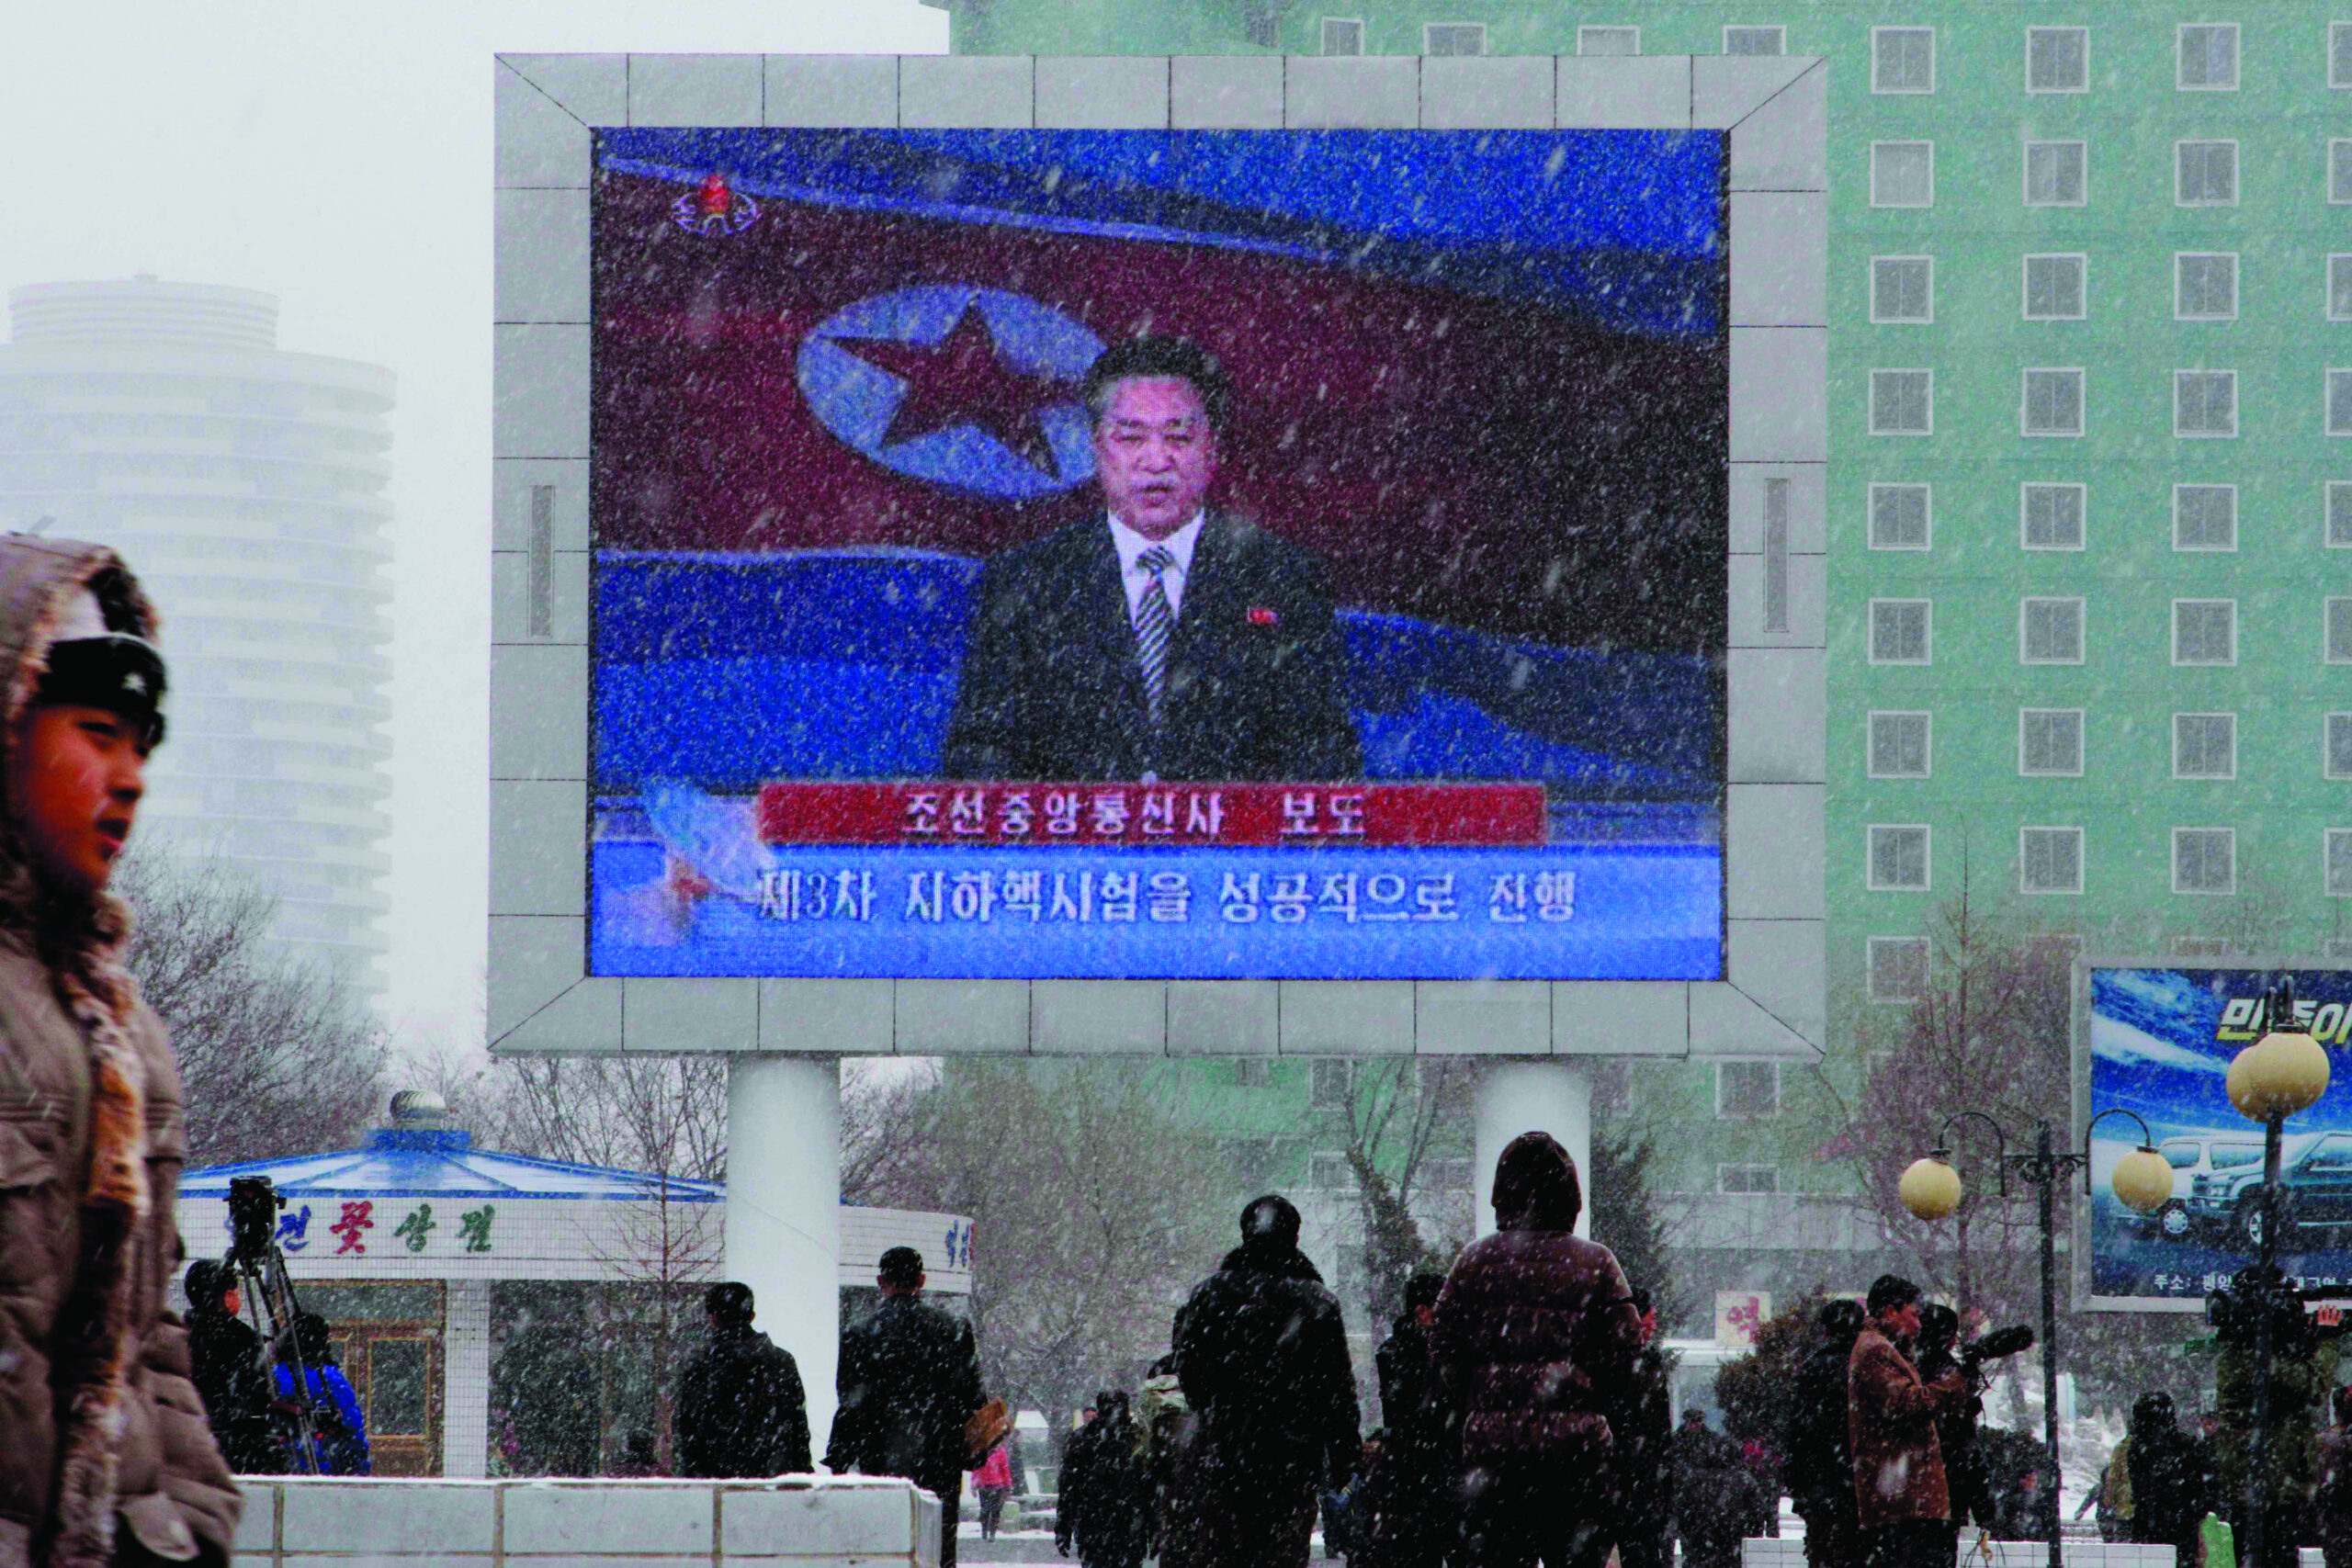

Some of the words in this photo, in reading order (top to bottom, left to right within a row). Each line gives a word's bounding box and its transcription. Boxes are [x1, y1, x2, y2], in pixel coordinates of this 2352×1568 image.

[901, 791, 1226, 836] 조선중앙통신사
[1281, 792, 1366, 835] 보도
[759, 870, 876, 921] 제3차
[905, 870, 1192, 922] 지하핵시험을
[1219, 871, 1460, 922] 성공적으로
[1488, 870, 1575, 921] 진행
